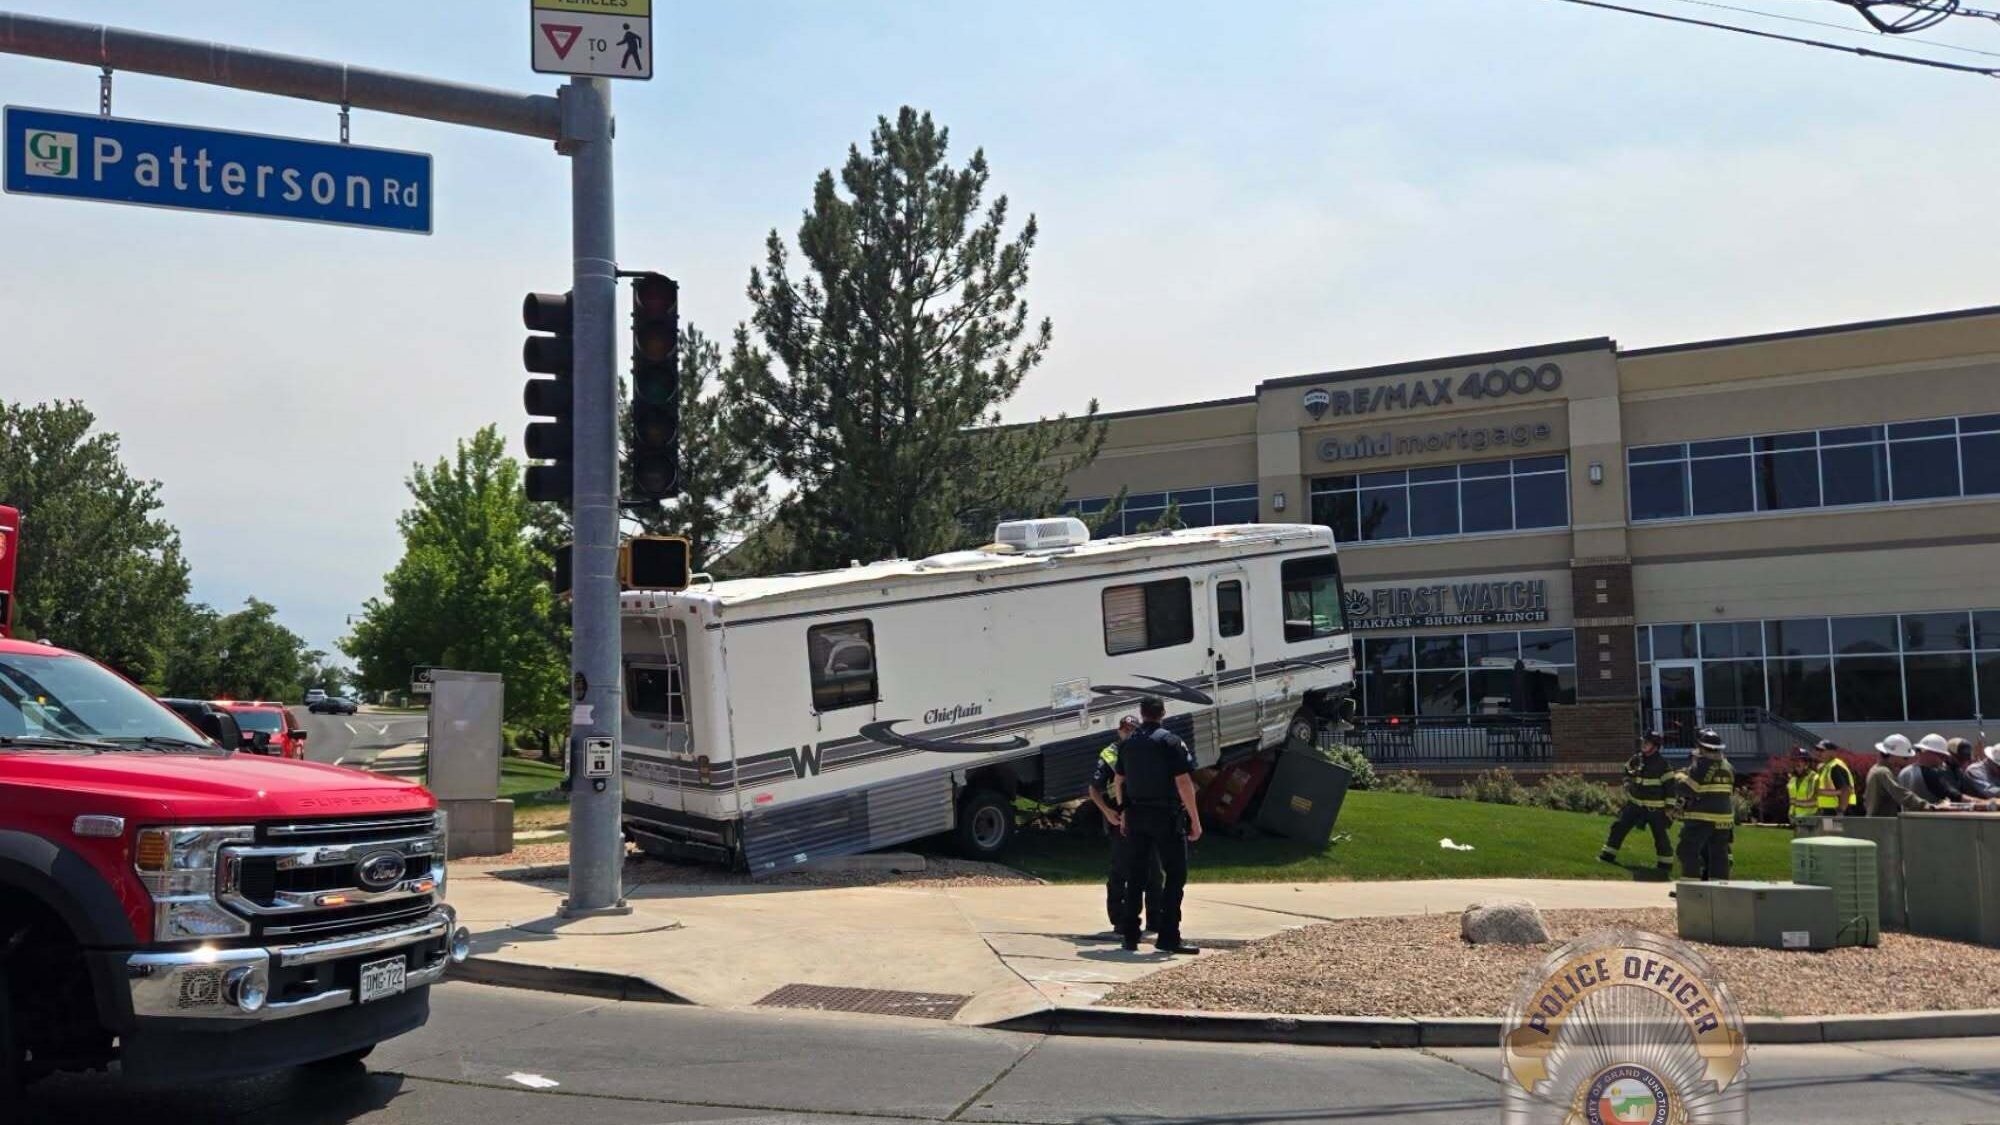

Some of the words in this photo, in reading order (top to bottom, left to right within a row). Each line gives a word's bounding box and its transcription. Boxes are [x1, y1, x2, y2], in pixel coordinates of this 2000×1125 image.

[587, 38, 607, 52] TO
[93, 136, 372, 209] Patterson
[383, 177, 418, 208] Rd
[1331, 378, 1453, 416] RE/MAX
[1457, 362, 1562, 399] 4000
[1317, 432, 1392, 462] Guild
[1395, 421, 1552, 456] mortgage
[1372, 584, 1448, 616] FIRST
[1453, 579, 1546, 612] WATCH
[1348, 616, 1412, 629] EAKFAST
[1425, 613, 1482, 626] BRUNCH
[1496, 610, 1545, 622] LUNCH
[924, 702, 982, 725] Chieftain
[792, 743, 823, 779] W
